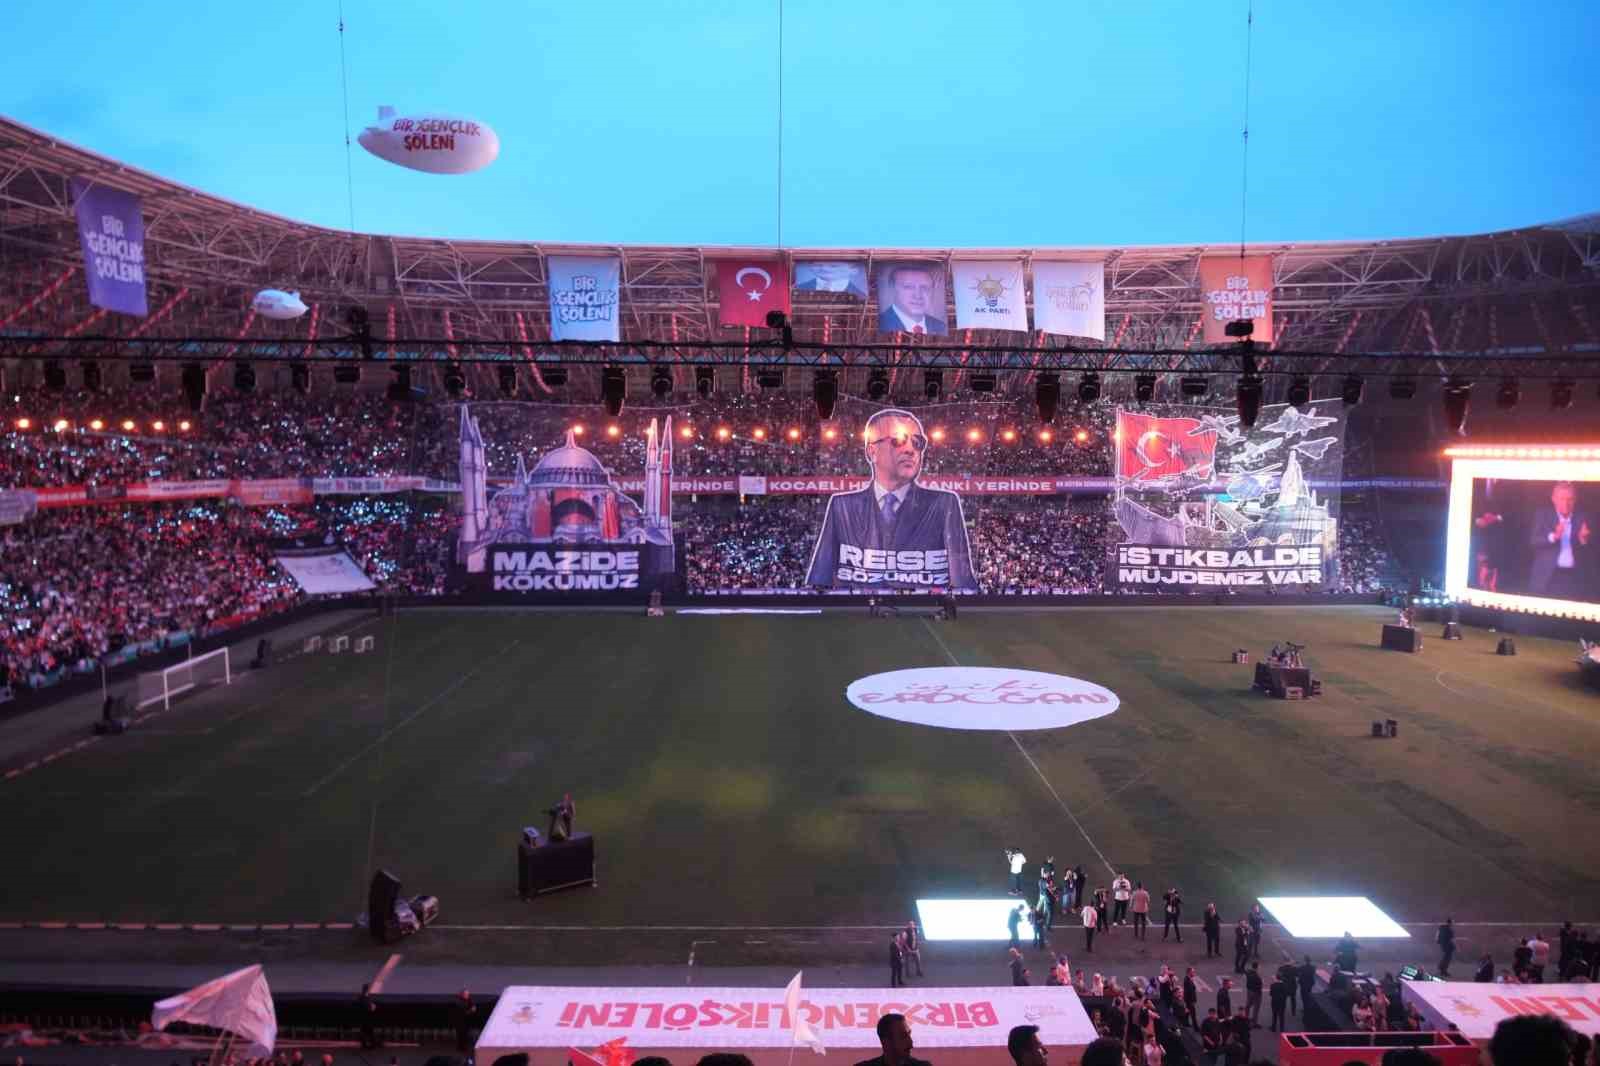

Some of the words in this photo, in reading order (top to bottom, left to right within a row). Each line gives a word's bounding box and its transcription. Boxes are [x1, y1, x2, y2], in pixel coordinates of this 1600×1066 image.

[404, 132, 455, 151] ŞÖLENİ
[671, 479, 734, 491] ERİNDE
[770, 479, 845, 491] KOCAELİ
[975, 478, 1051, 491] YERİNDE
[493, 570, 640, 590] KÖKÜMÜZ
[837, 567, 949, 585] SÖZÜMÜZ
[1266, 568, 1322, 584] VAR
[556, 1000, 724, 1031] ŞÖLENİ
[926, 1001, 1000, 1029] BİR
